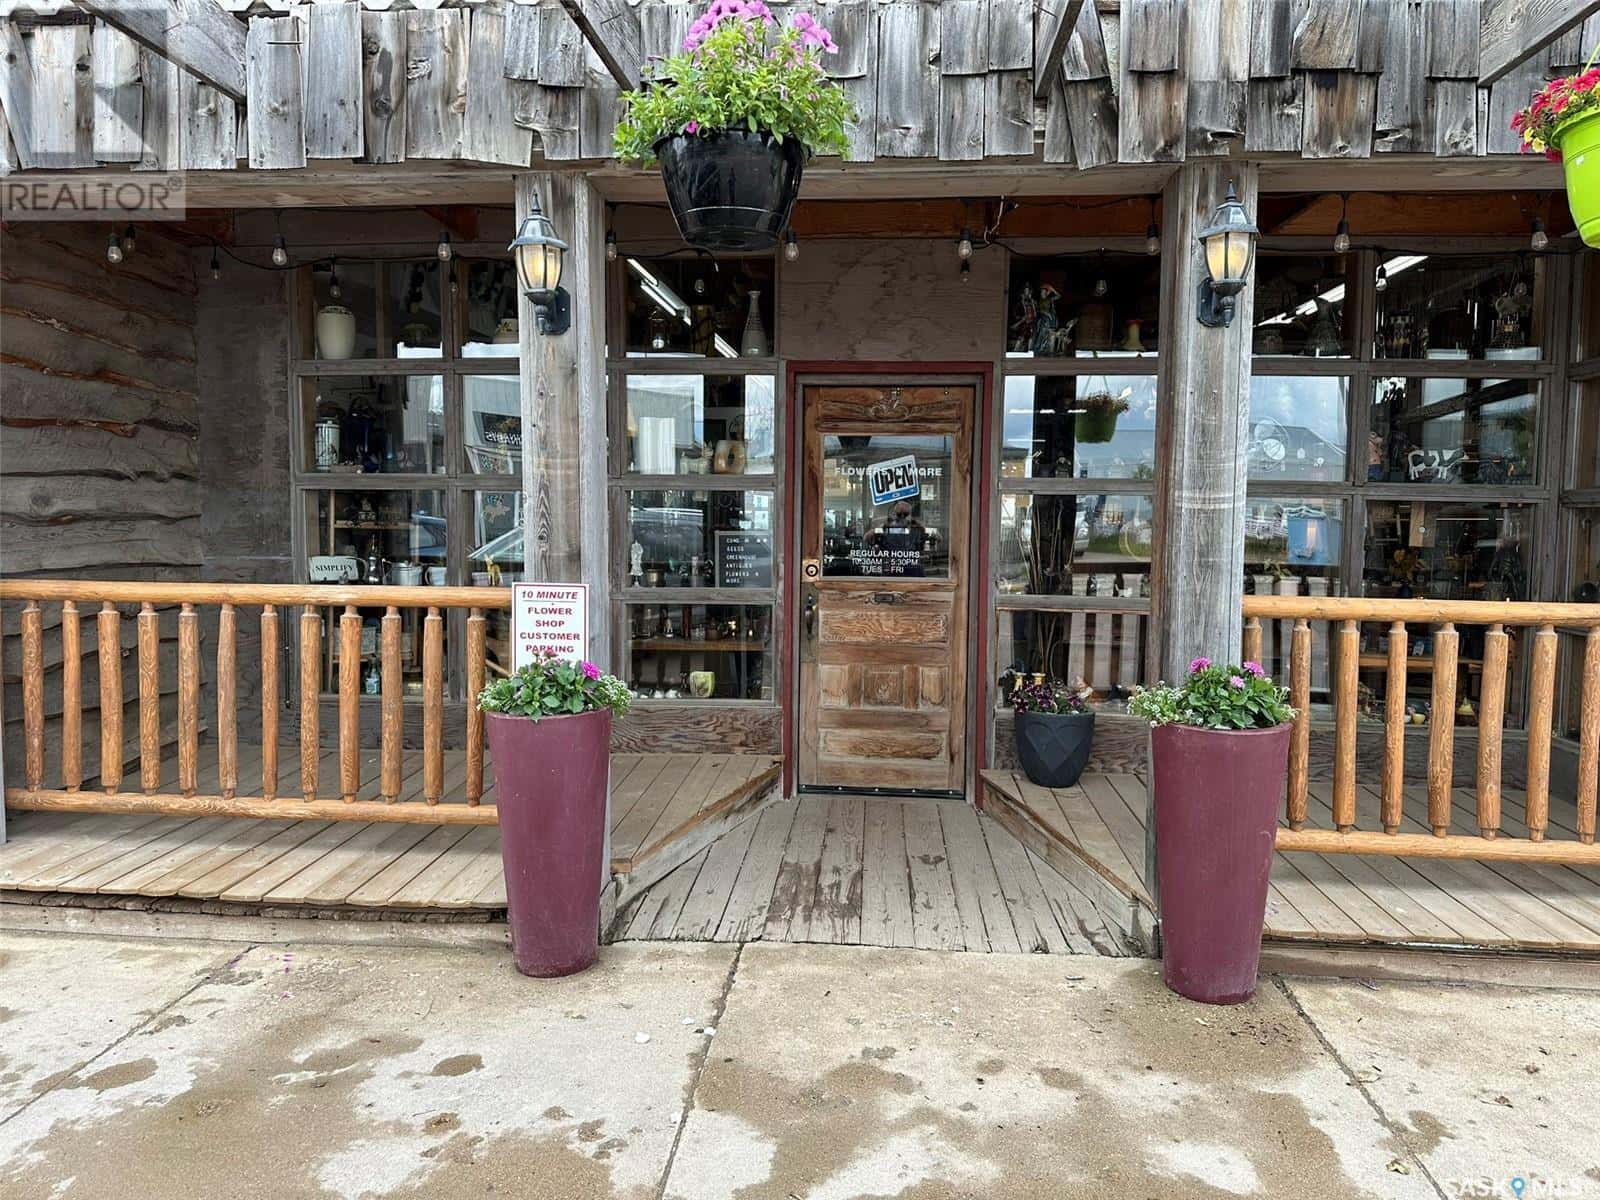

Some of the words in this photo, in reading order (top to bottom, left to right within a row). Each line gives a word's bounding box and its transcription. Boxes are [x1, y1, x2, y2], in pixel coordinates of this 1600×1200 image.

[835, 466, 888, 476] FLOWERS
[909, 466, 943, 477] MORE
[874, 463, 914, 494] OPEN
[850, 549, 889, 558] REGULAR
[891, 550, 920, 559] HOURS
[852, 557, 882, 566] 10:30AM
[891, 558, 918, 566] 5:30PM
[861, 565, 882, 574] TUES
[891, 565, 904, 573] FRI
[522, 591, 533, 599] 10
[536, 591, 578, 600] MINUTE
[528, 607, 573, 616] FLOWER
[535, 620, 565, 628] SHOP
[520, 632, 581, 641] CUSTOMER
[526, 644, 575, 653] PARKING
